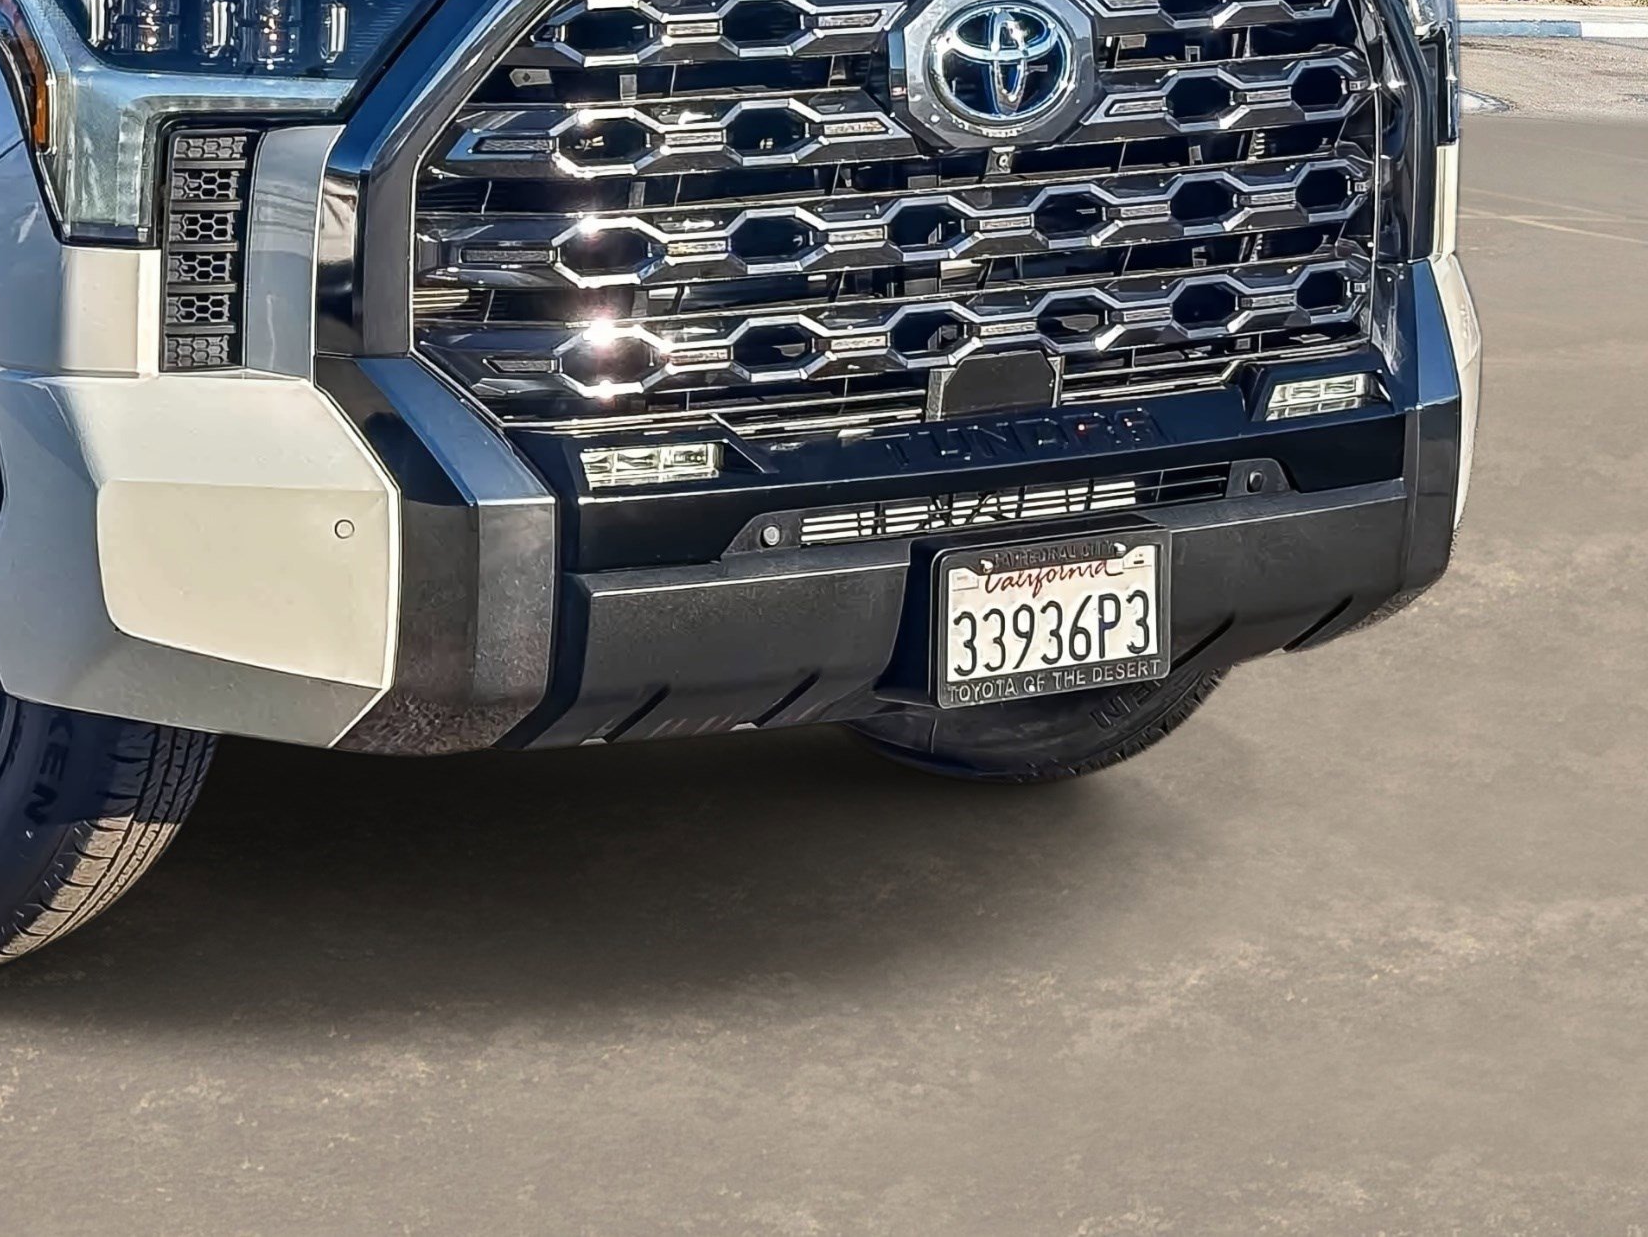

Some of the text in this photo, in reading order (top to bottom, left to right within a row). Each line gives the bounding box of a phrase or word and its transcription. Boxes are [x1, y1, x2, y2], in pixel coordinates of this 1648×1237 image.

[864, 407, 1174, 467] TUNDRA
[953, 588, 1150, 677] 33936P3
[947, 677, 1018, 702] TOYOTA
[1052, 669, 1086, 689] THE
[1092, 659, 1161, 683] DESERT
